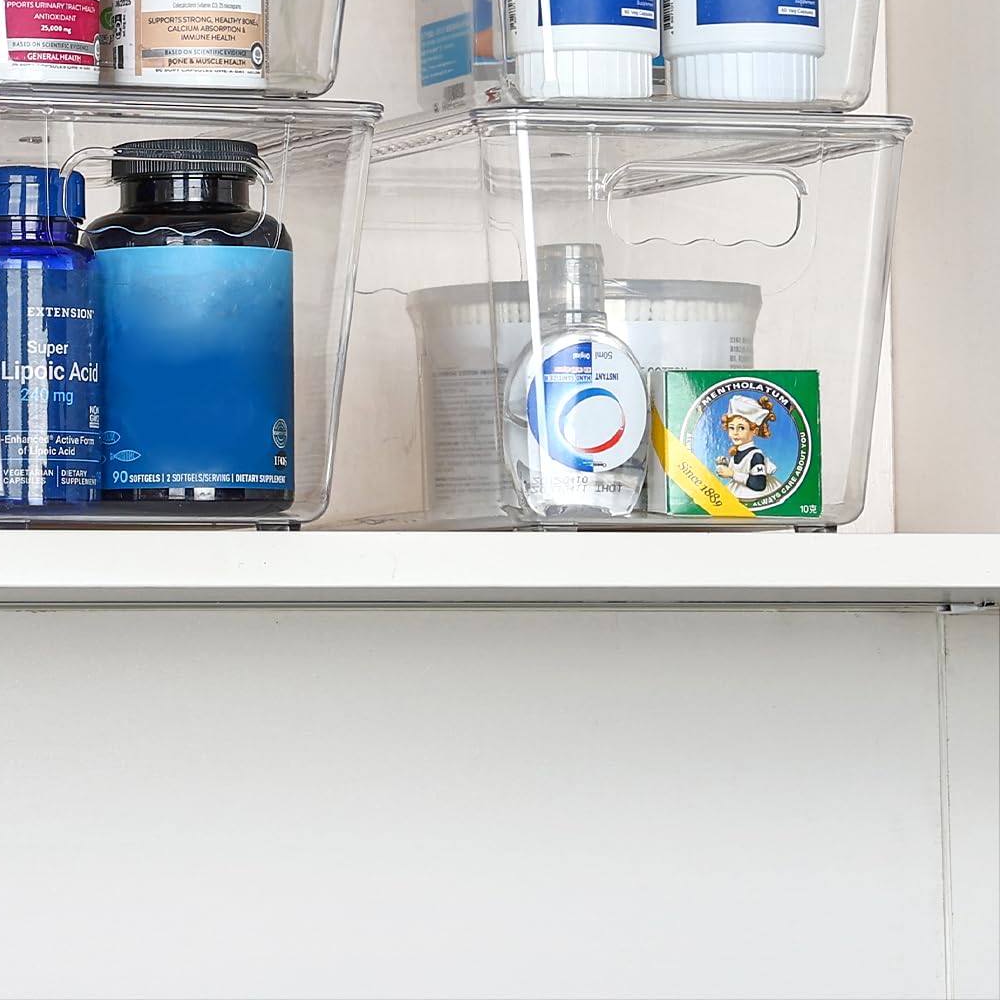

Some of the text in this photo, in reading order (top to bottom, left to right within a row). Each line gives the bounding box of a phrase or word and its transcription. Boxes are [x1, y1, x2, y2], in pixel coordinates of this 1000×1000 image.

[35, 1, 68, 10] URINARY
[33, 13, 77, 22] ANTIOXIDANT
[183, 16, 213, 24] STRONG,
[214, 17, 241, 25] HEALTHY
[40, 24, 72, 35] 25,000 mg
[42, 41, 69, 49] SCIENTIFIC
[27, 53, 82, 62] GENERAL HEALTH
[27, 306, 93, 319] EXTENSION
[27, 340, 69, 357] Super
[594, 351, 613, 360] 50ml
[69, 361, 99, 383] Acid
[595, 373, 619, 381] INSTANT
[20, 387, 74, 406] 240 mg
[702, 381, 789, 407] MENTHOLATUM
[55, 435, 80, 445] Active
[80, 436, 95, 446] Form
[799, 432, 808, 450] YOU
[18, 446, 76, 457] of Lipoic Acid
[795, 452, 807, 478] ABOUT
[3, 469, 54, 477] VEGETARIAN
[61, 469, 88, 477] DIETARY
[112, 470, 286, 484] 90 SOFTGELS 2 SOFTGELS/SERVING DIETARY SUPPLEMENT
[3, 477, 47, 485] CAPSULES
[61, 477, 97, 486] SUPPLEMENT
[781, 477, 798, 495] CARE
[699, 482, 724, 508] 1889
